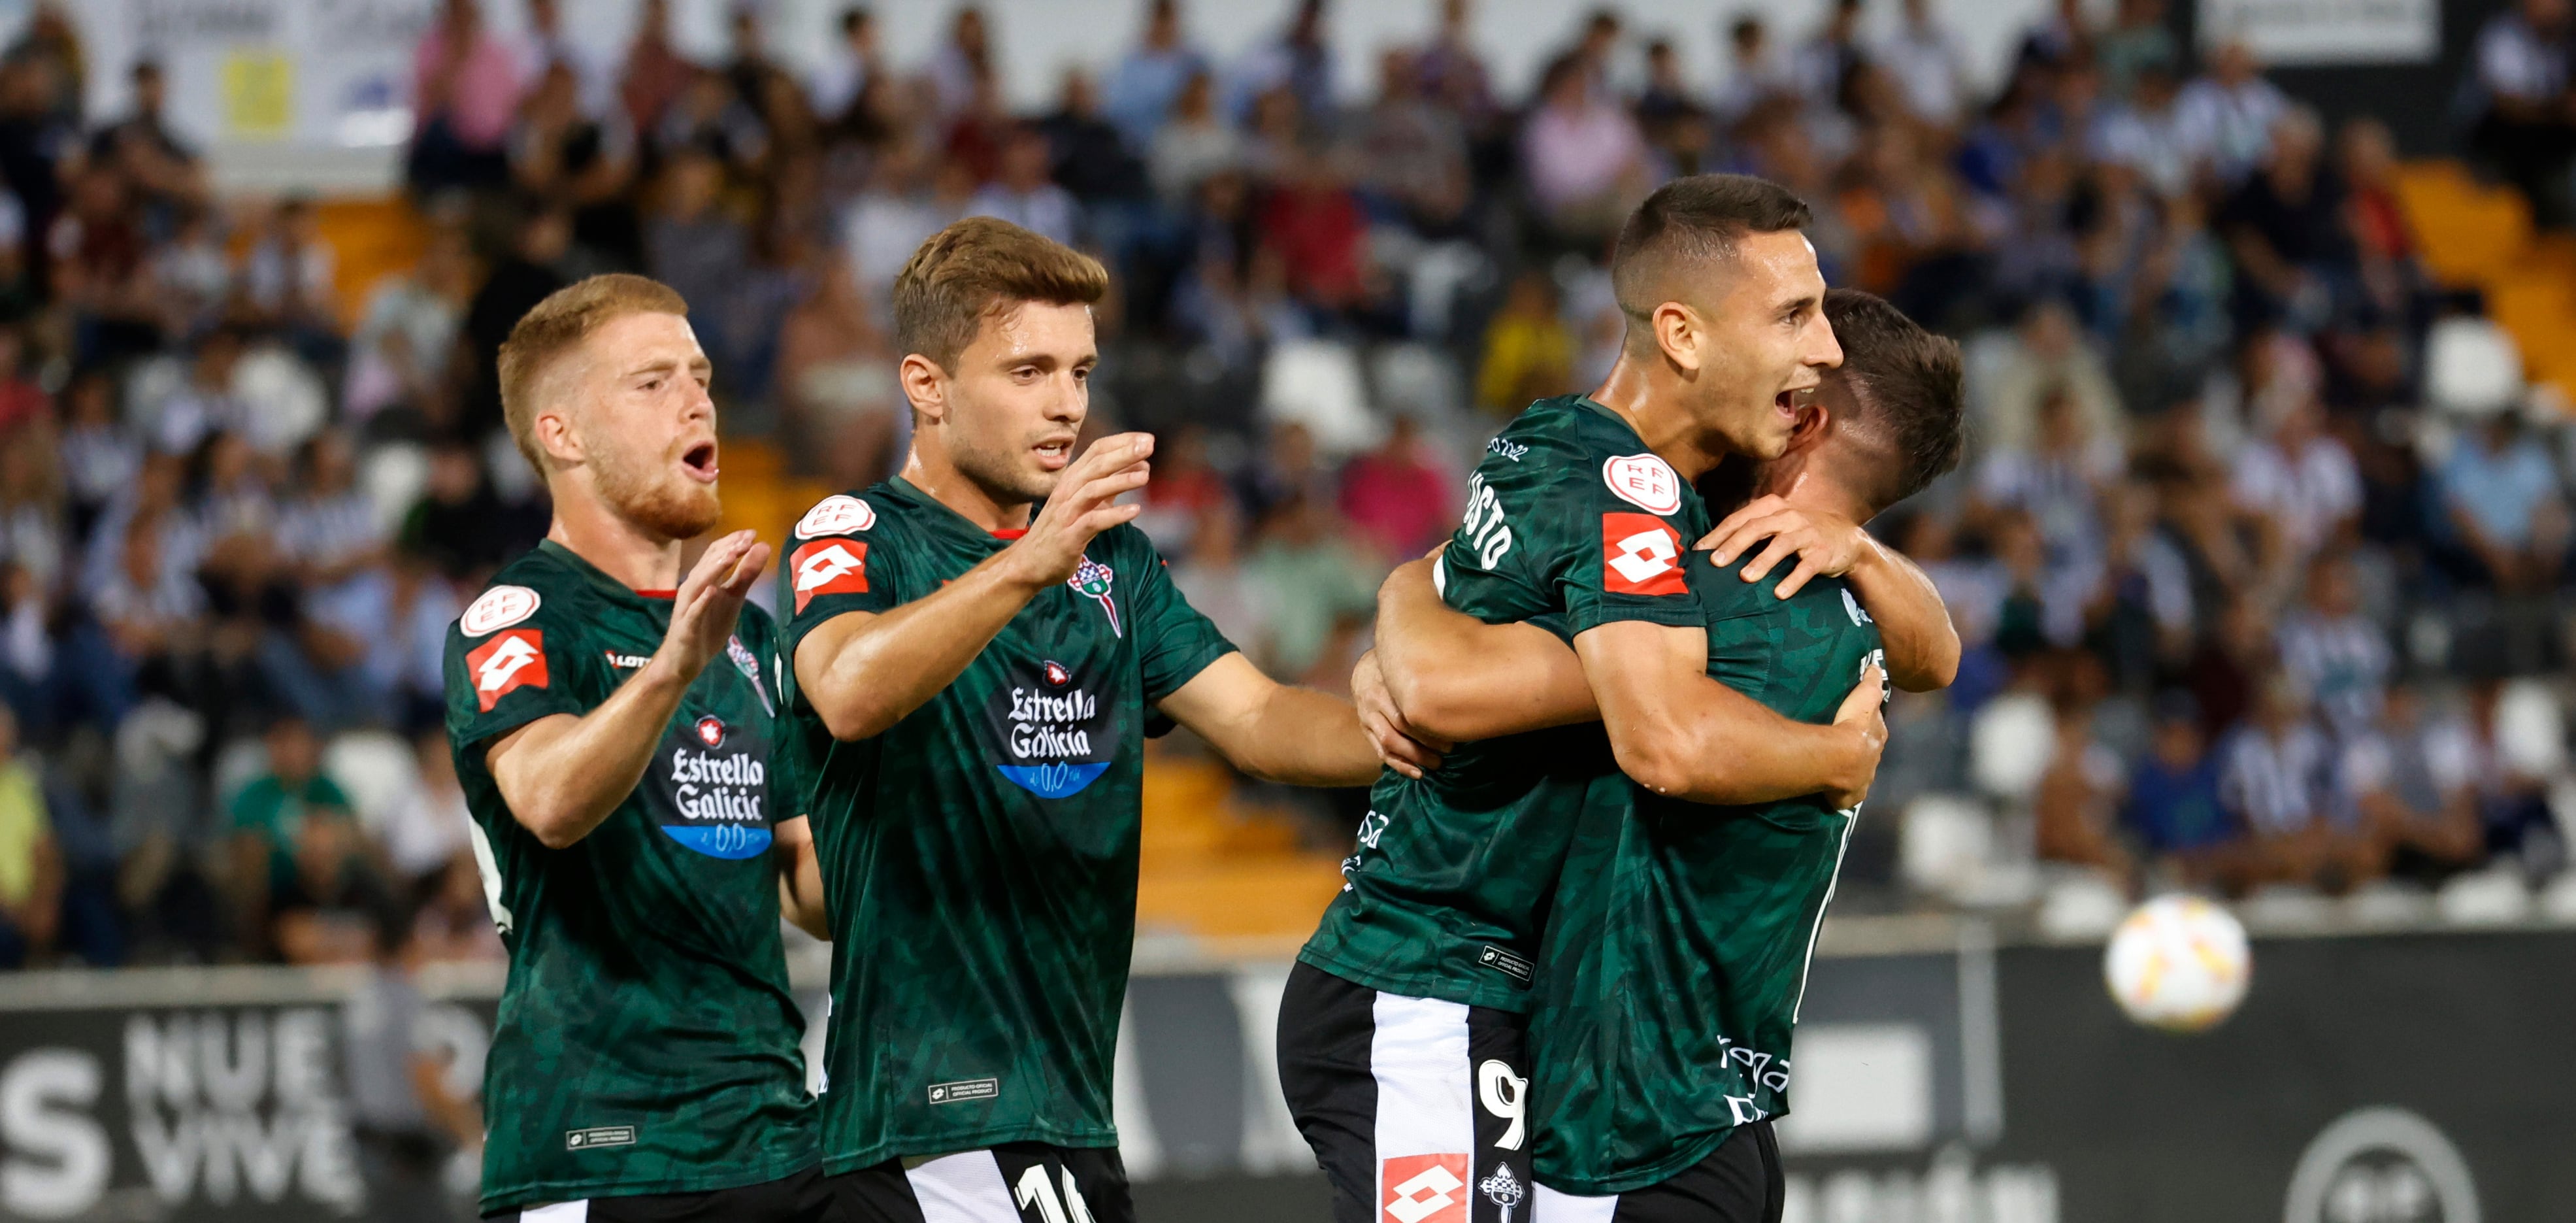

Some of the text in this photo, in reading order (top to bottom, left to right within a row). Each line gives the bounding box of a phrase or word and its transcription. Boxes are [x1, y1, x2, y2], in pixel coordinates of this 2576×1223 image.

[1008, 687, 1095, 722] Estrella
[1011, 722, 1091, 759] Galicia
[671, 748, 764, 786] Estrella
[1479, 1060, 1528, 1150] 9
